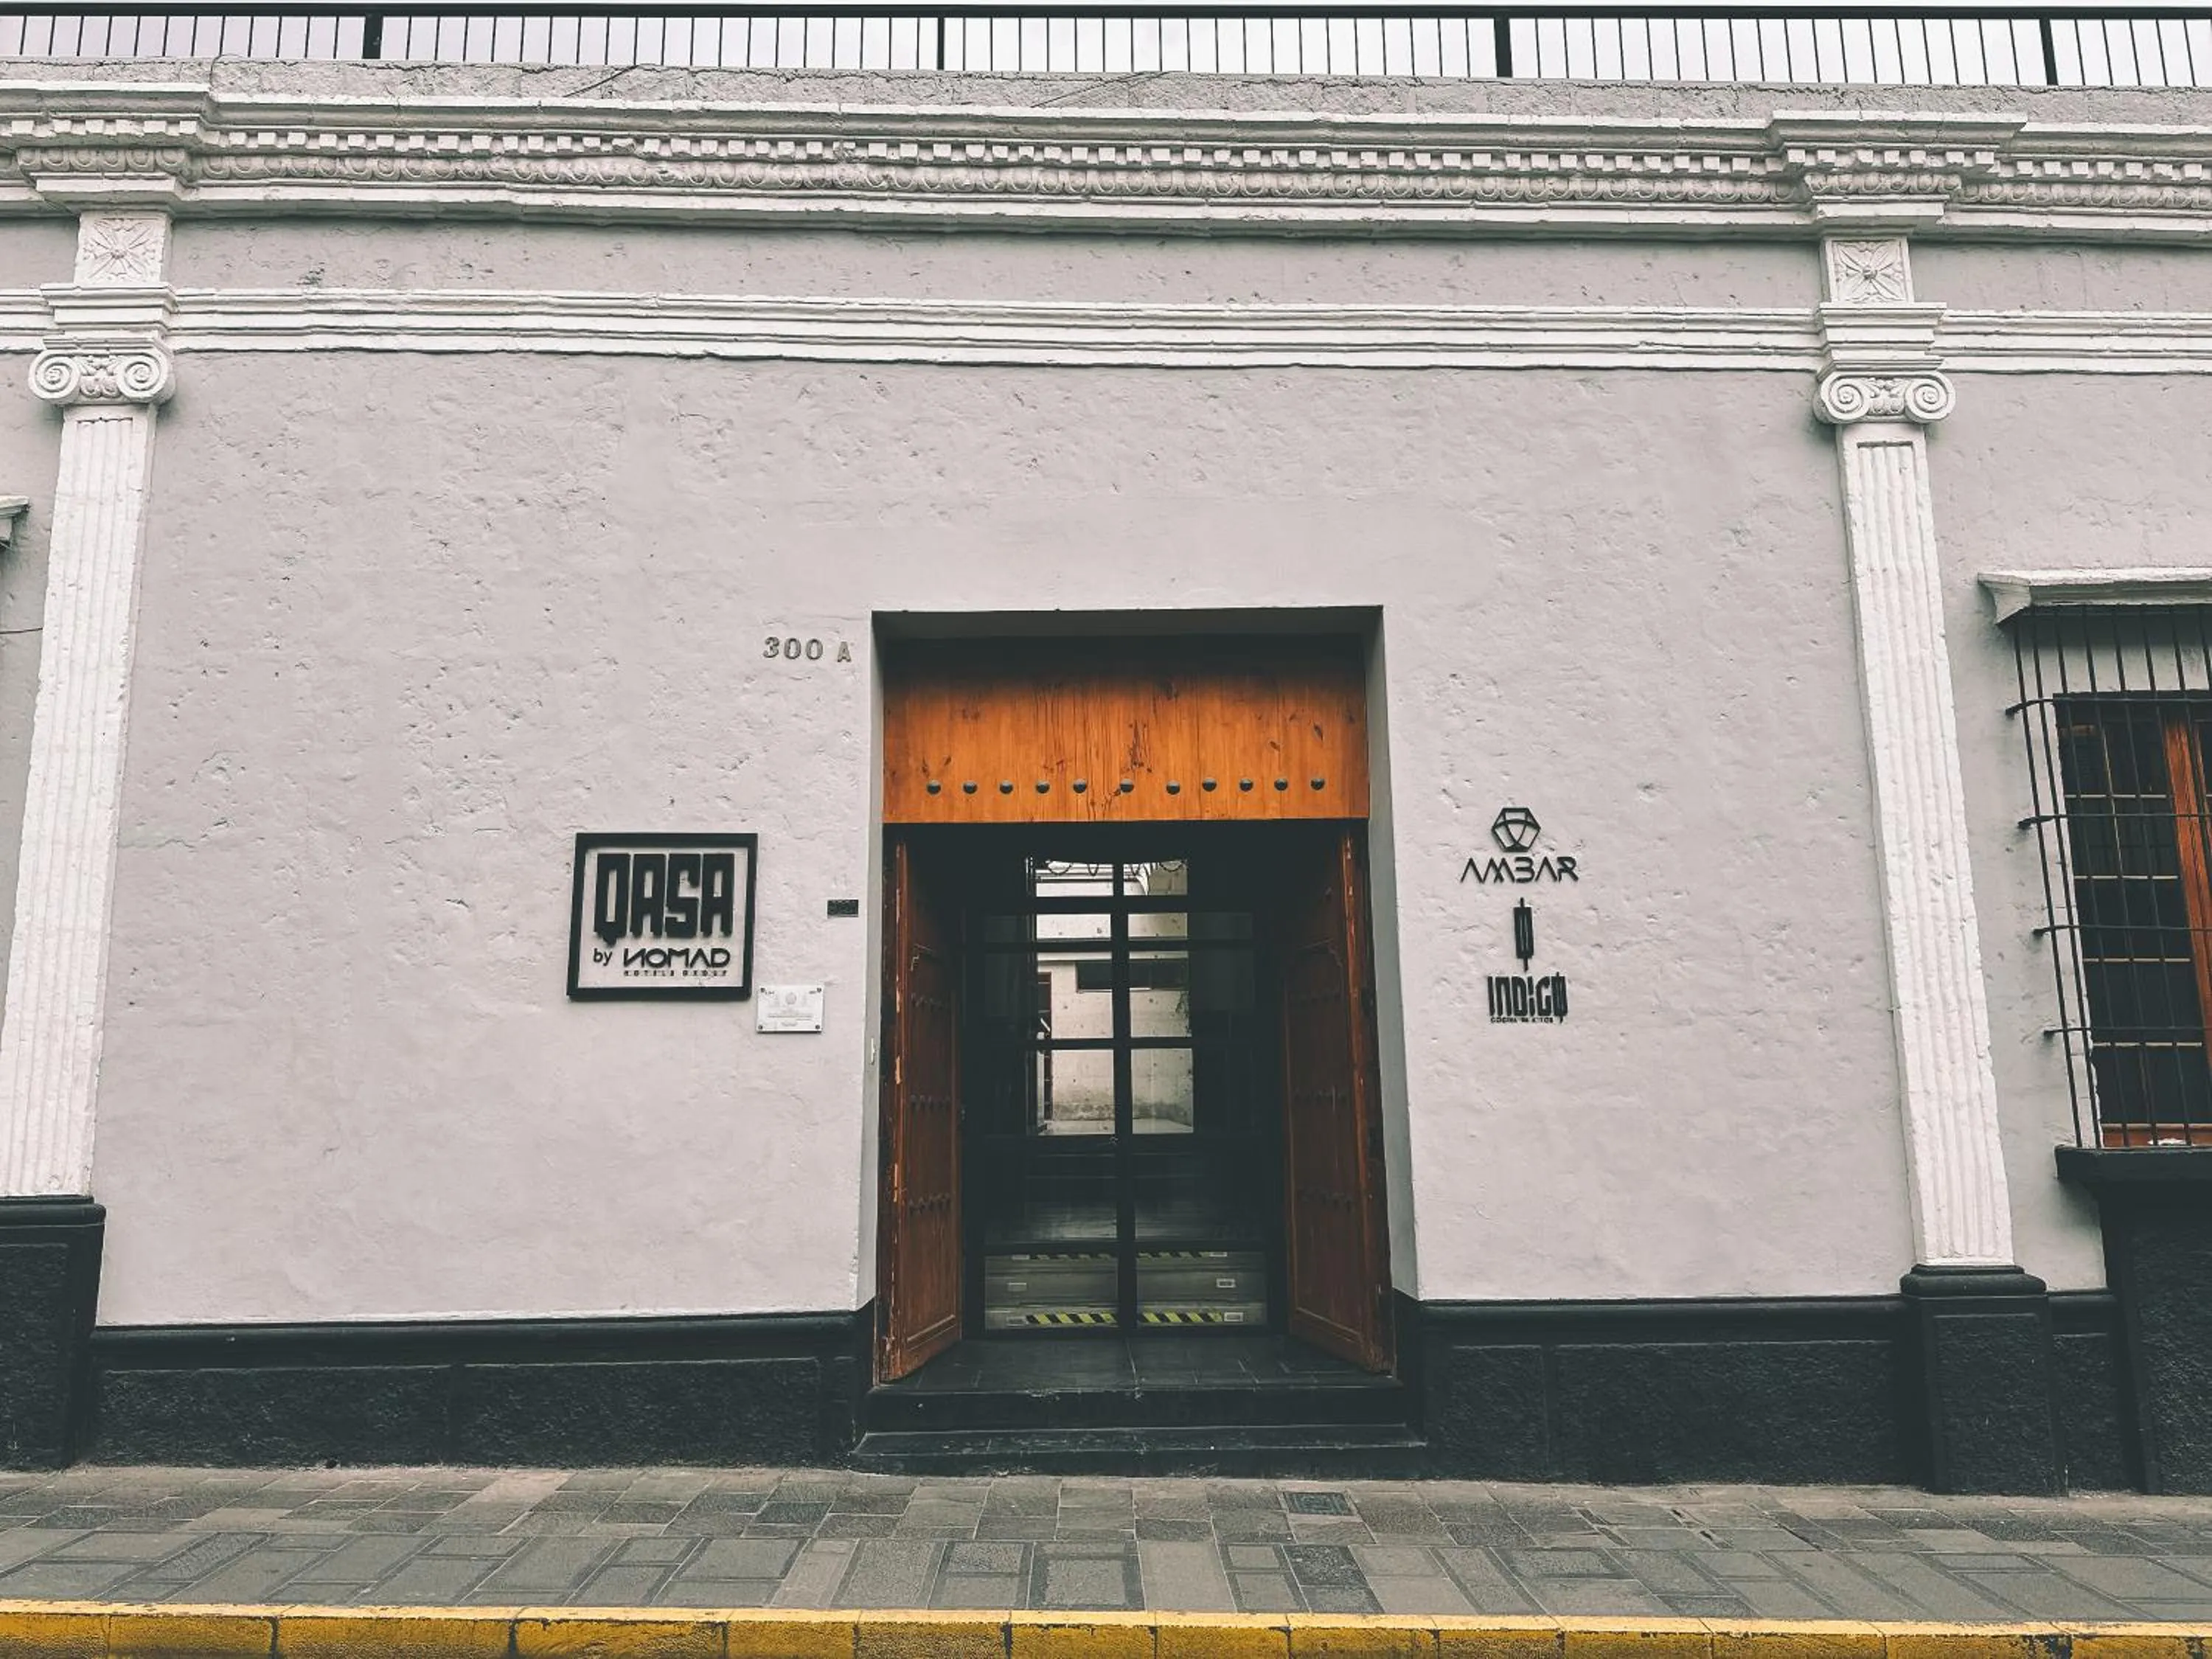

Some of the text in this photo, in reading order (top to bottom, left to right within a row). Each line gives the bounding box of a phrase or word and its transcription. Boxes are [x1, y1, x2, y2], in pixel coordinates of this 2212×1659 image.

[763, 636, 852, 663] 300 A
[1460, 856, 1579, 883] AMBAR
[594, 853, 735, 947] QASA
[593, 947, 731, 968] by NOMAD
